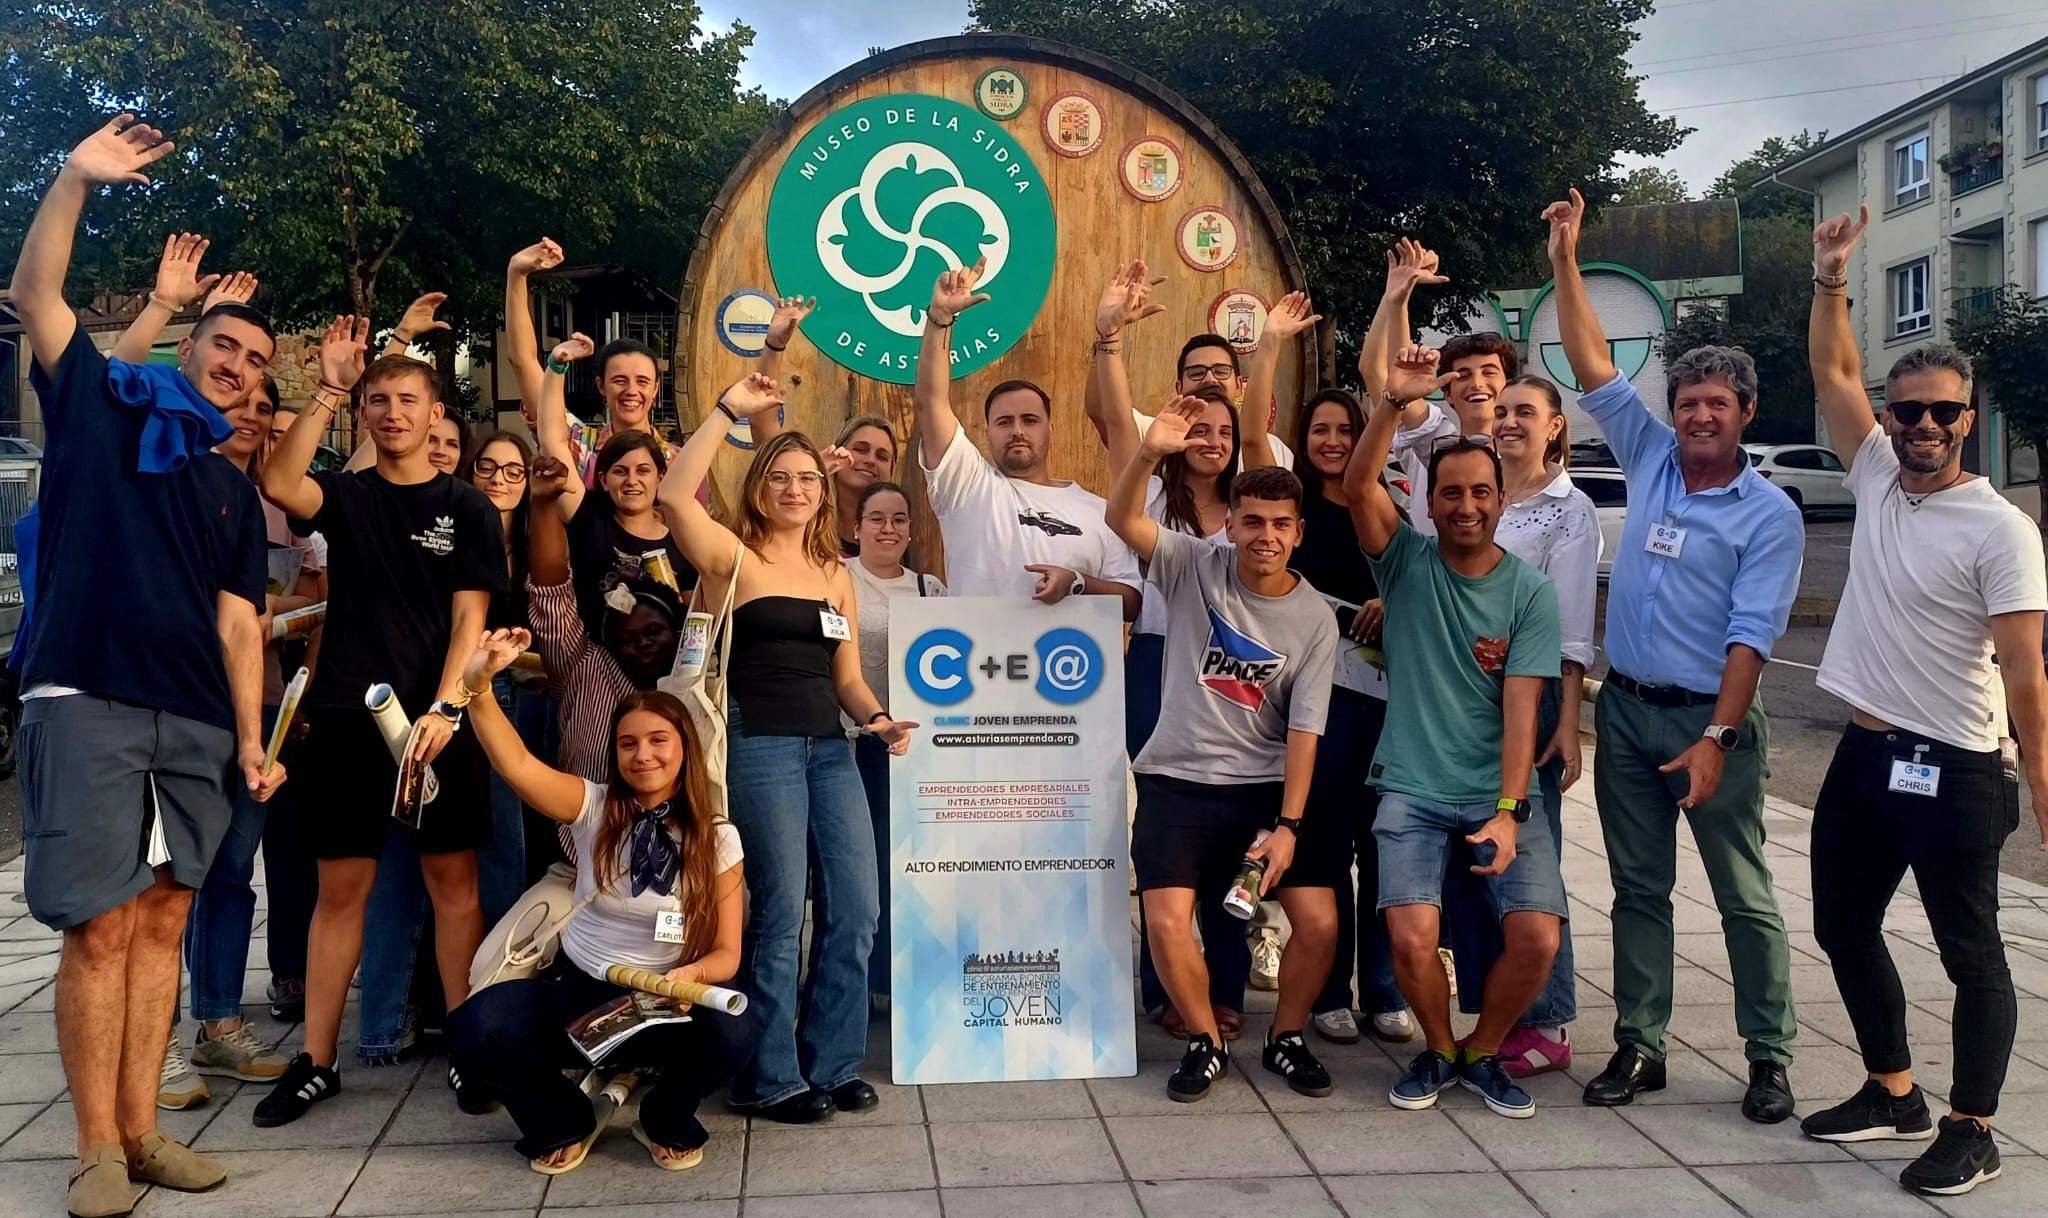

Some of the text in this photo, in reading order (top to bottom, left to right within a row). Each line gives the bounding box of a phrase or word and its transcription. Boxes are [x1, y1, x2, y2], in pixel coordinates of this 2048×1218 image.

[800, 108, 1030, 194] MUSEO DE LA SIDRA
[836, 327, 1000, 370] DE ASRIAS
[1652, 541, 1674, 553] KIKE
[973, 716, 1010, 726] JOVEN
[1012, 715, 1078, 725] EMPRENDA
[936, 732, 1075, 745] www.asturiasemprenda.org
[918, 784, 1091, 794] EMPRENDEDORES EMPRESARIALES
[1897, 778, 1932, 792] CHRIS
[947, 797, 1067, 807] INTRA-EMPRENDEDORES
[935, 809, 1075, 820] EMPRENDEDORES SOCIALES
[905, 858, 1116, 873] ALTO RENDIMIENTO EMPRENDEDOR
[963, 974, 1016, 983] PROGRAMA
[963, 981, 1061, 991] DE ENTRENAMIENTO
[963, 995, 1061, 1018] DEL JOVEN
[963, 1016, 1063, 1028] CAPITAL HUMANO
